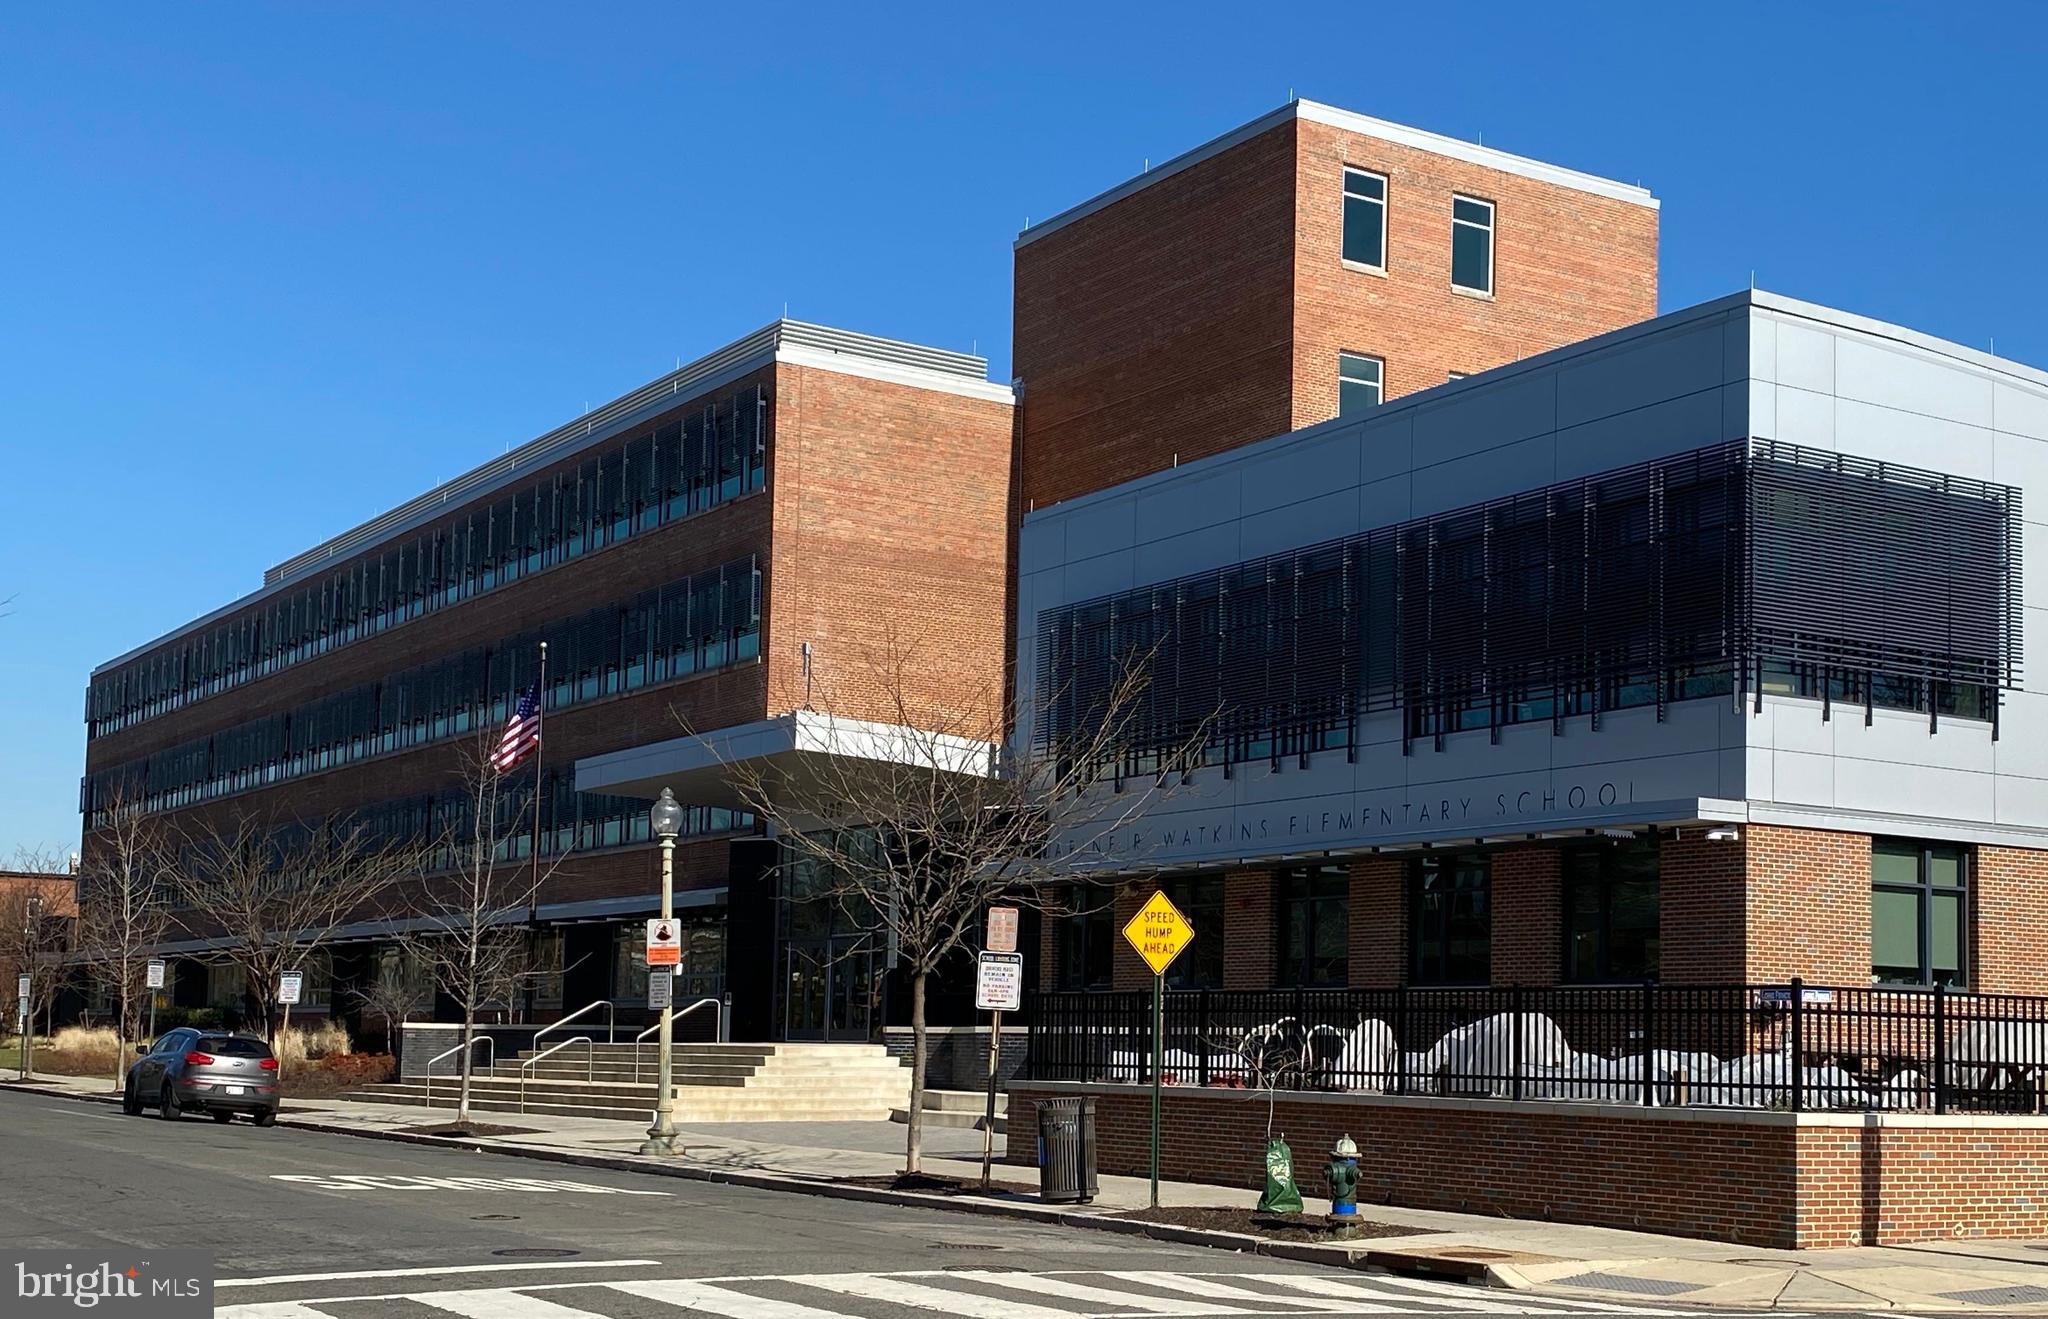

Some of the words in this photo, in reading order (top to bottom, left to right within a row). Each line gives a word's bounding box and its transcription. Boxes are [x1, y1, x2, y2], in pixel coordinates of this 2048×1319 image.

[1162, 819, 1270, 848] WATKINS
[1289, 798, 1472, 835] ELEMENTARY
[1496, 781, 1636, 815] SCHOOL
[1144, 911, 1175, 923] SPEED
[1145, 928, 1172, 938] HUMP
[1143, 943, 1175, 954] AHEAD
